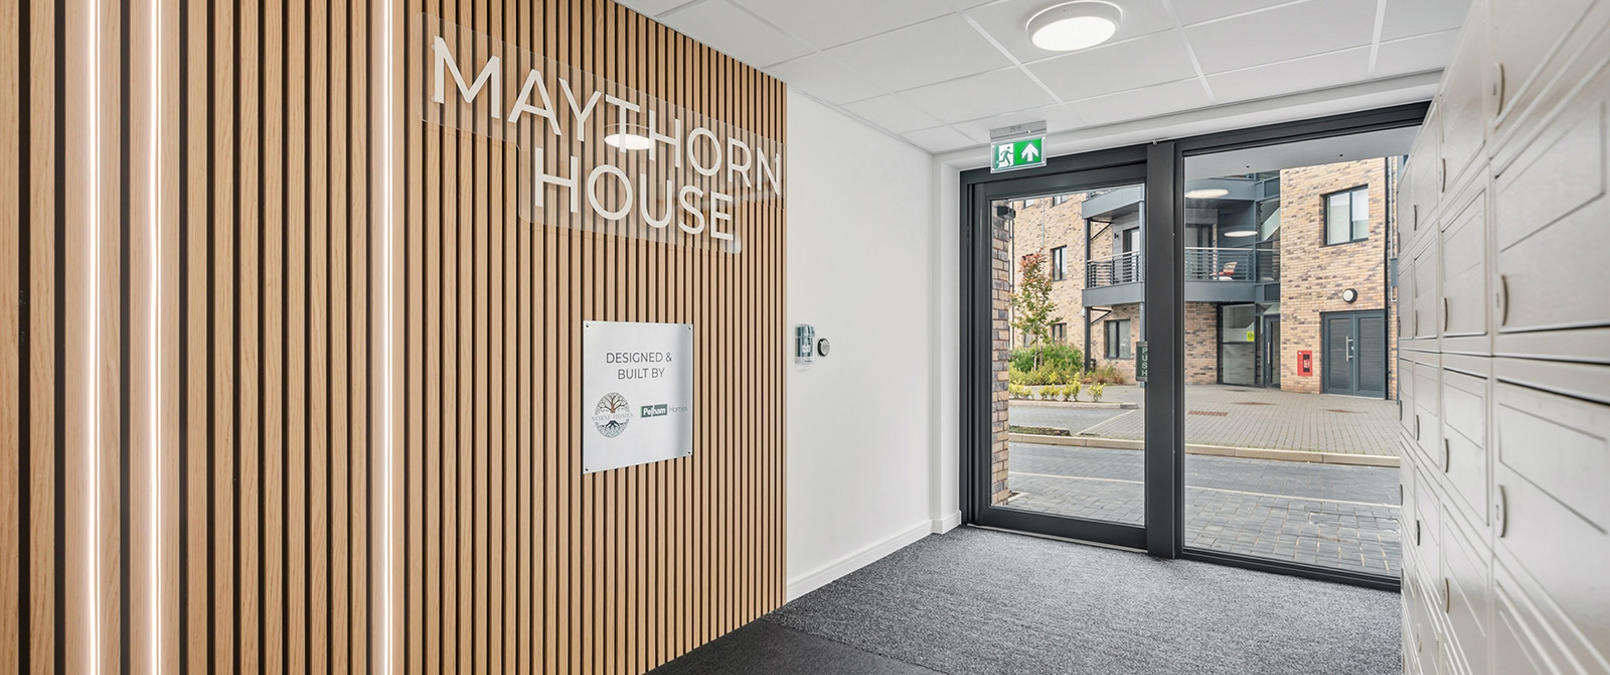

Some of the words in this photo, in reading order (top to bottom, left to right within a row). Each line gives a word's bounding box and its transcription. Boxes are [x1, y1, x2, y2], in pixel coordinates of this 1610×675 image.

[432, 35, 782, 197] MAYTHORN
[534, 147, 734, 242] HOUSE
[606, 352, 663, 364] DESIGNED
[665, 352, 672, 362] &
[617, 368, 649, 380] BUILT
[651, 367, 665, 378] BY
[643, 404, 667, 417] Pelham
